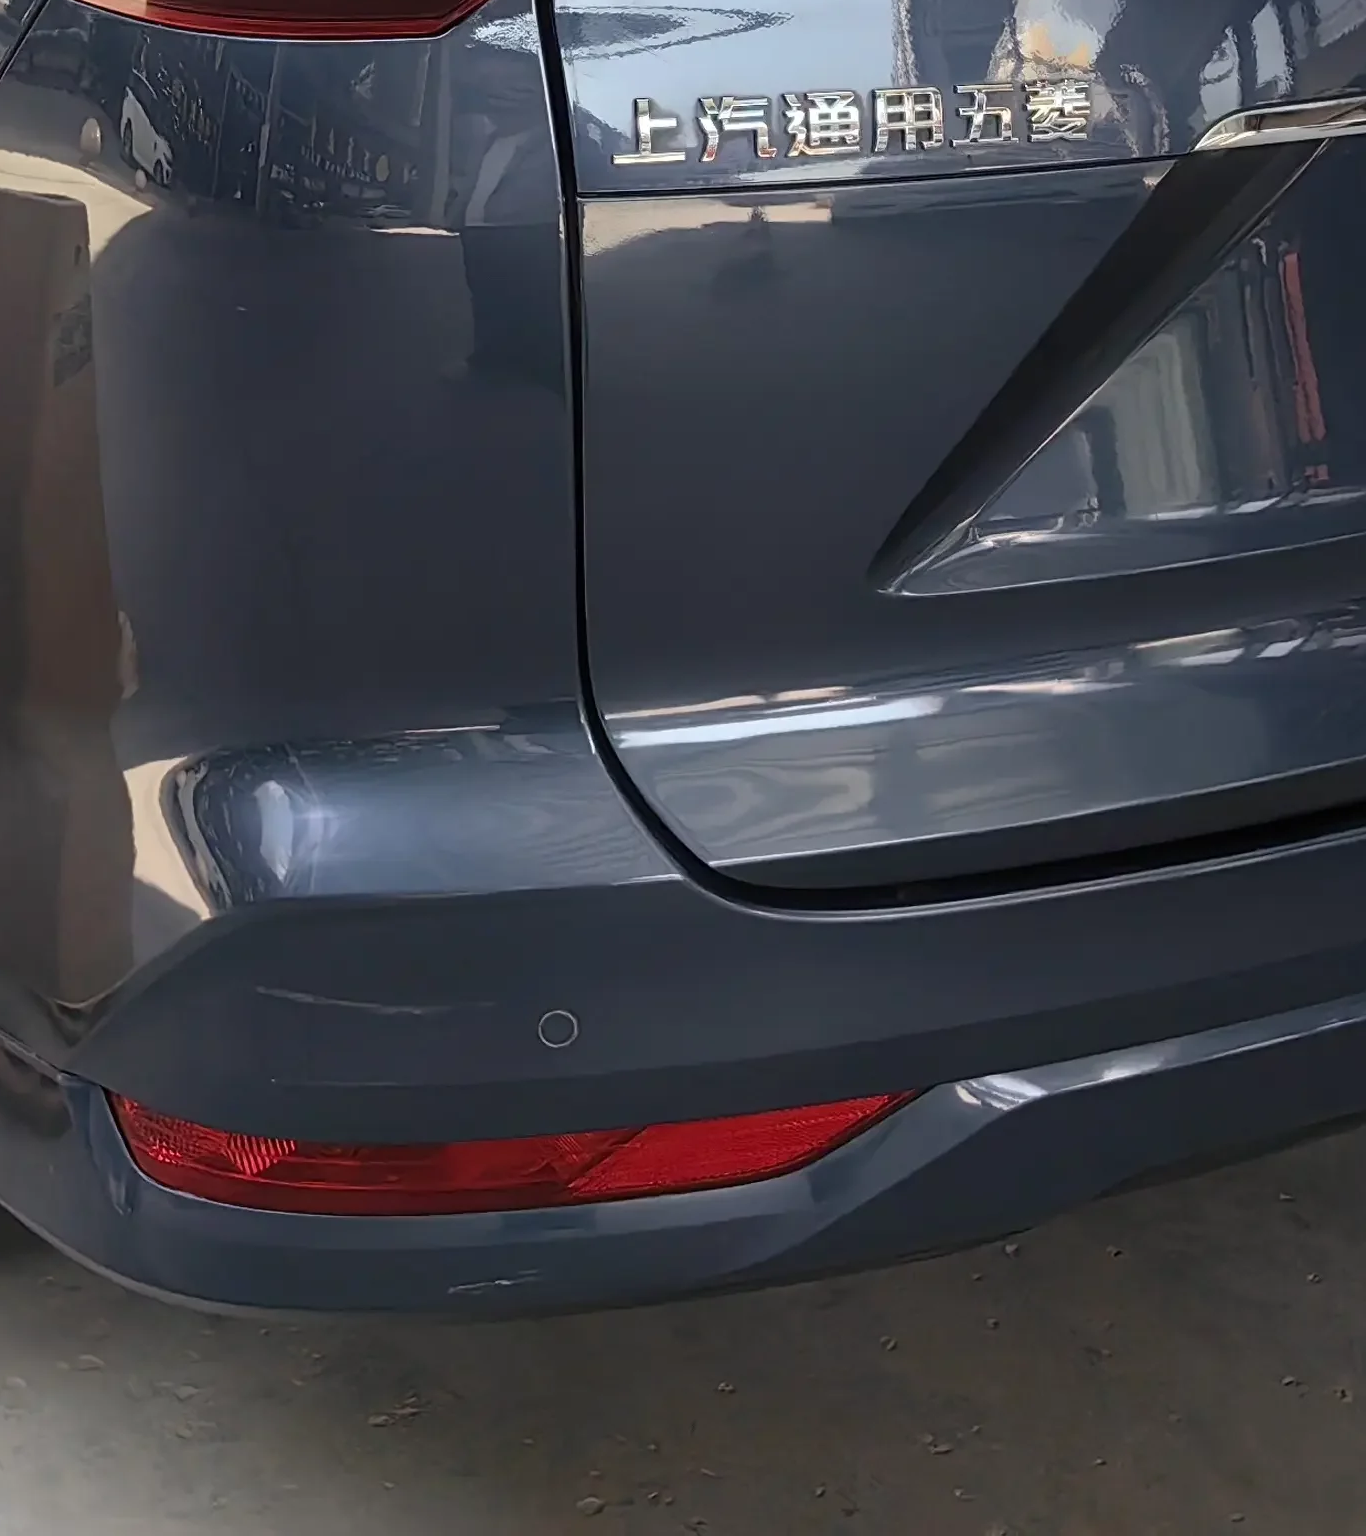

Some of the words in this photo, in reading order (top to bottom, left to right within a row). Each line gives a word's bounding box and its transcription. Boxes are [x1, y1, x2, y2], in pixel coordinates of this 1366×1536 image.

[611, 79, 1091, 164] 上汽通用五菱
